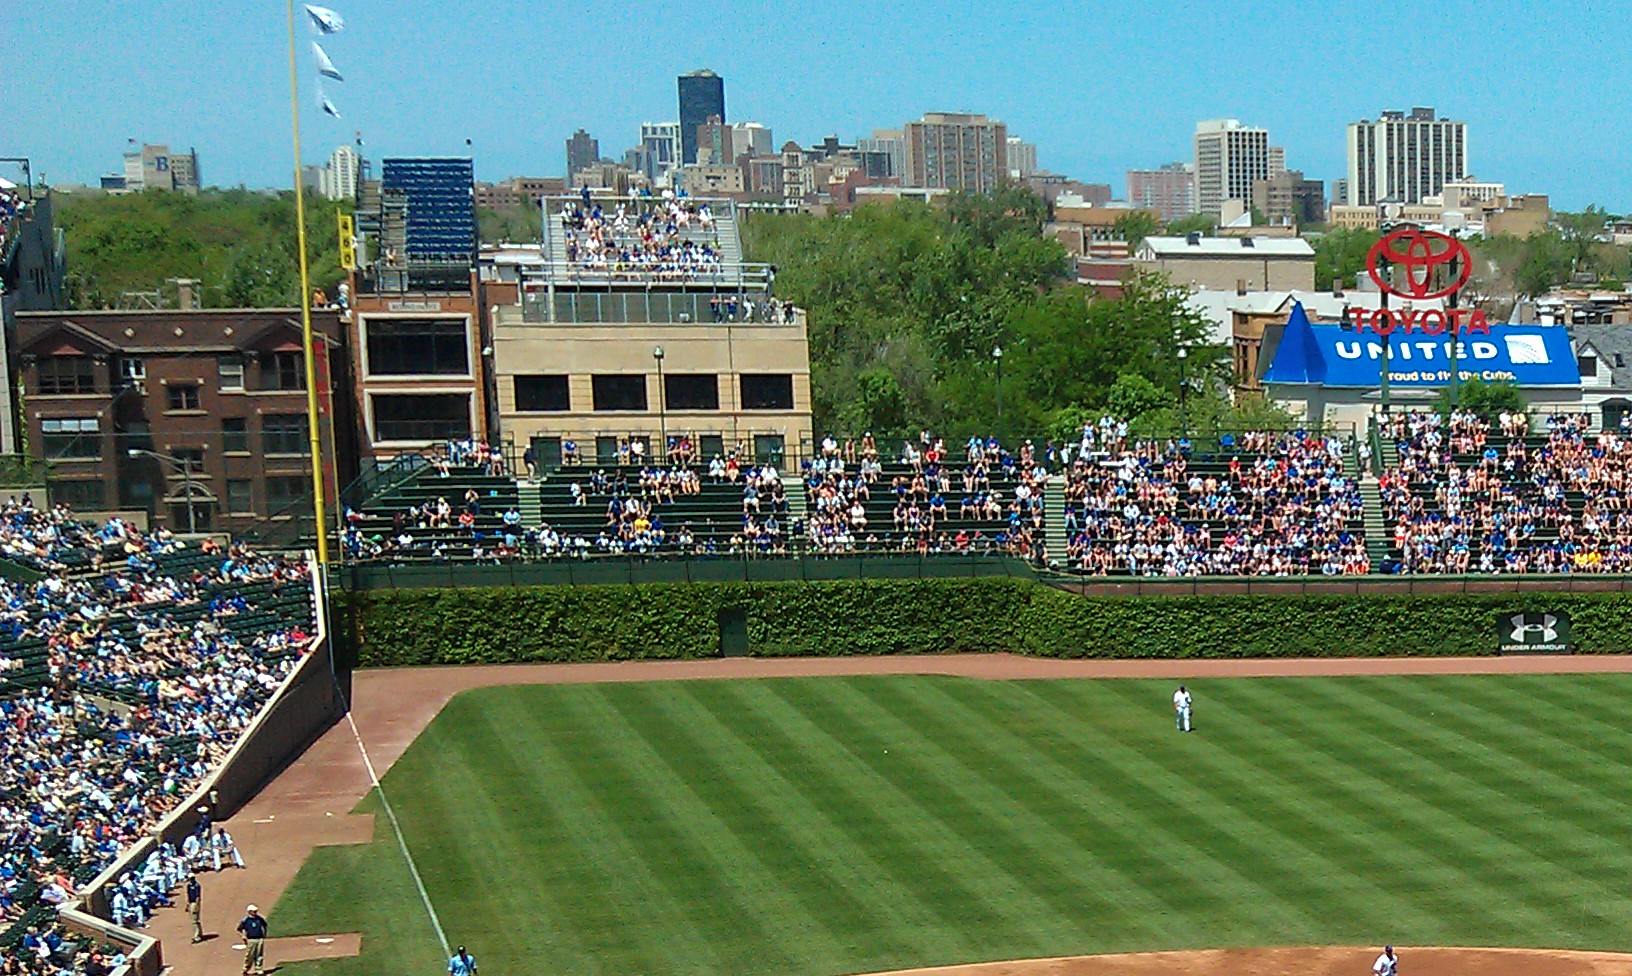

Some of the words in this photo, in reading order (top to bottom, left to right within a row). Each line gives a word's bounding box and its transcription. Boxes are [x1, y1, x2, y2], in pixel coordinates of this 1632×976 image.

[155, 156, 169, 172] B
[1348, 306, 1490, 336] TOYOTA
[1336, 341, 1498, 360] UNITED
[1379, 371, 1419, 381] roud
[1421, 371, 1436, 381] to
